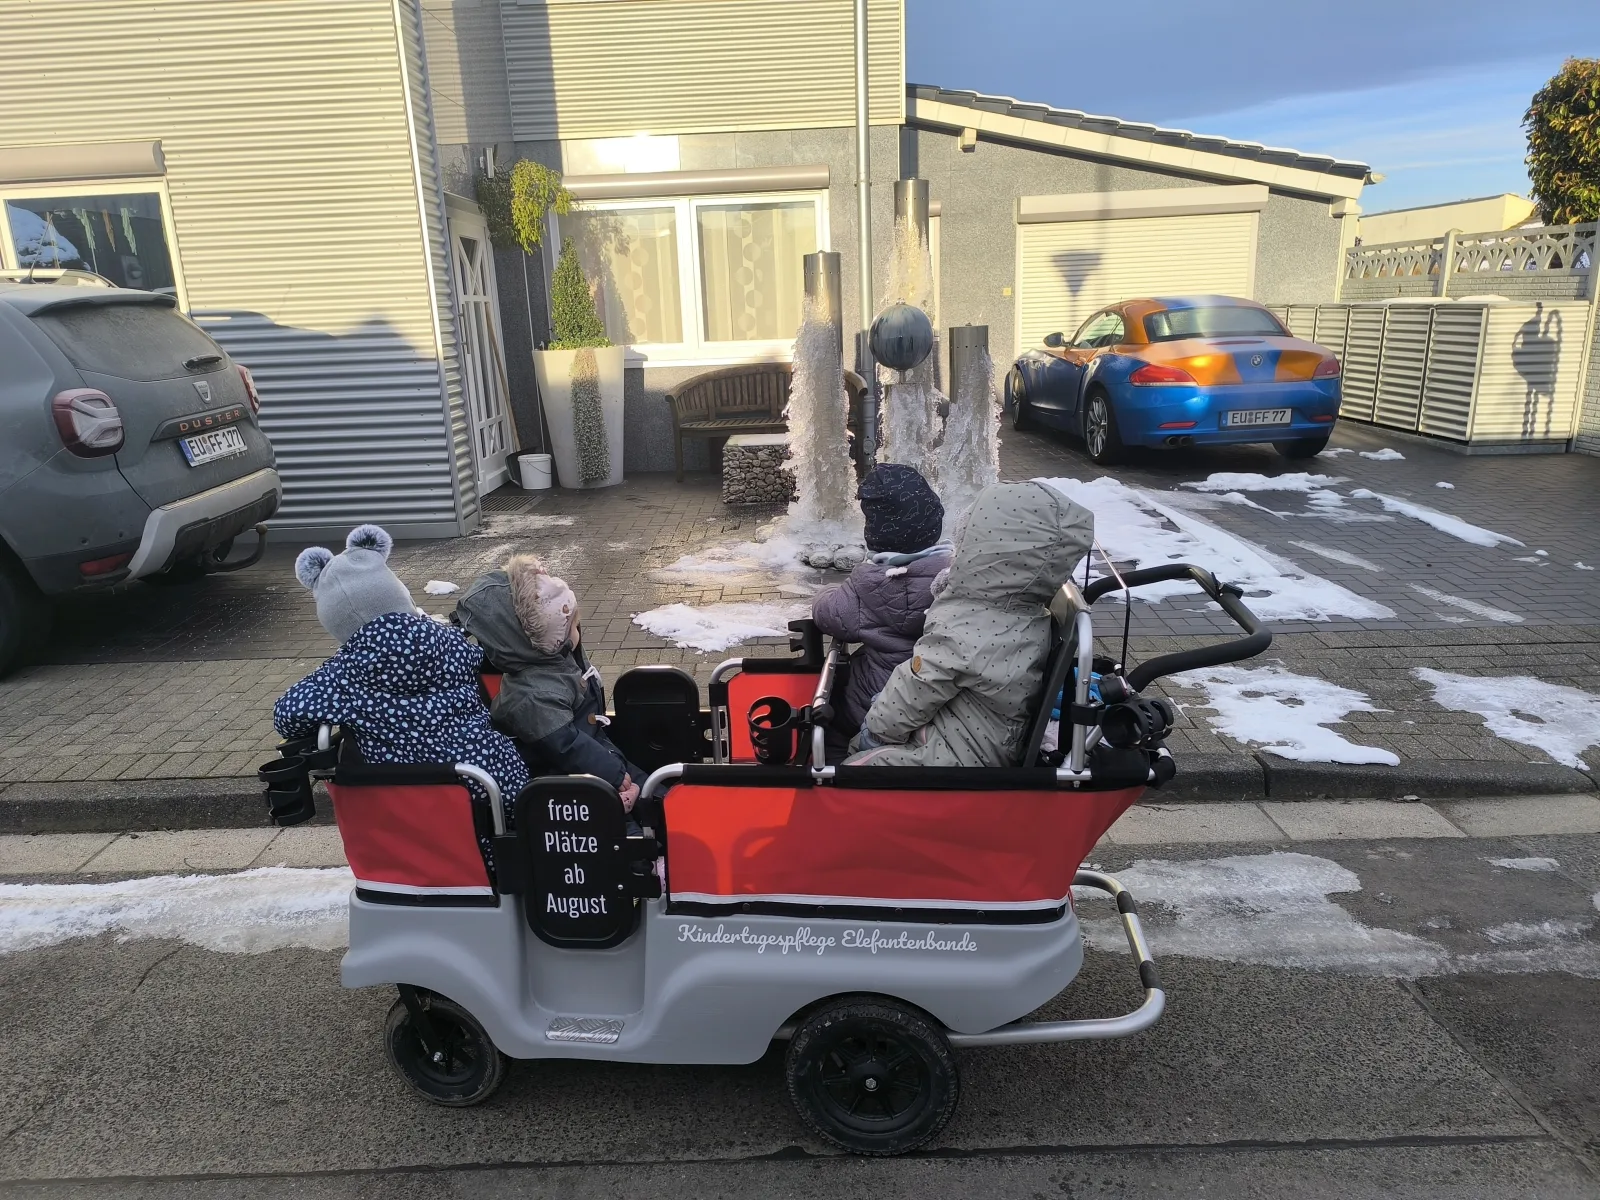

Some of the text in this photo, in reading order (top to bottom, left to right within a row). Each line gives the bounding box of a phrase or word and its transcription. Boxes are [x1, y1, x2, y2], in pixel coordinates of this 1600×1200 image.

[180, 409, 240, 431] DUSTER
[1232, 410, 1286, 424] EU FF 77
[187, 435, 207, 458] EU
[208, 433, 222, 452] FF
[222, 429, 241, 448] 177
[548, 799, 590, 821] freie
[544, 831, 598, 853] Plätze
[564, 863, 585, 884] ab
[546, 893, 608, 918] August
[677, 924, 978, 955] Kindertagespflege Elefantenbande
